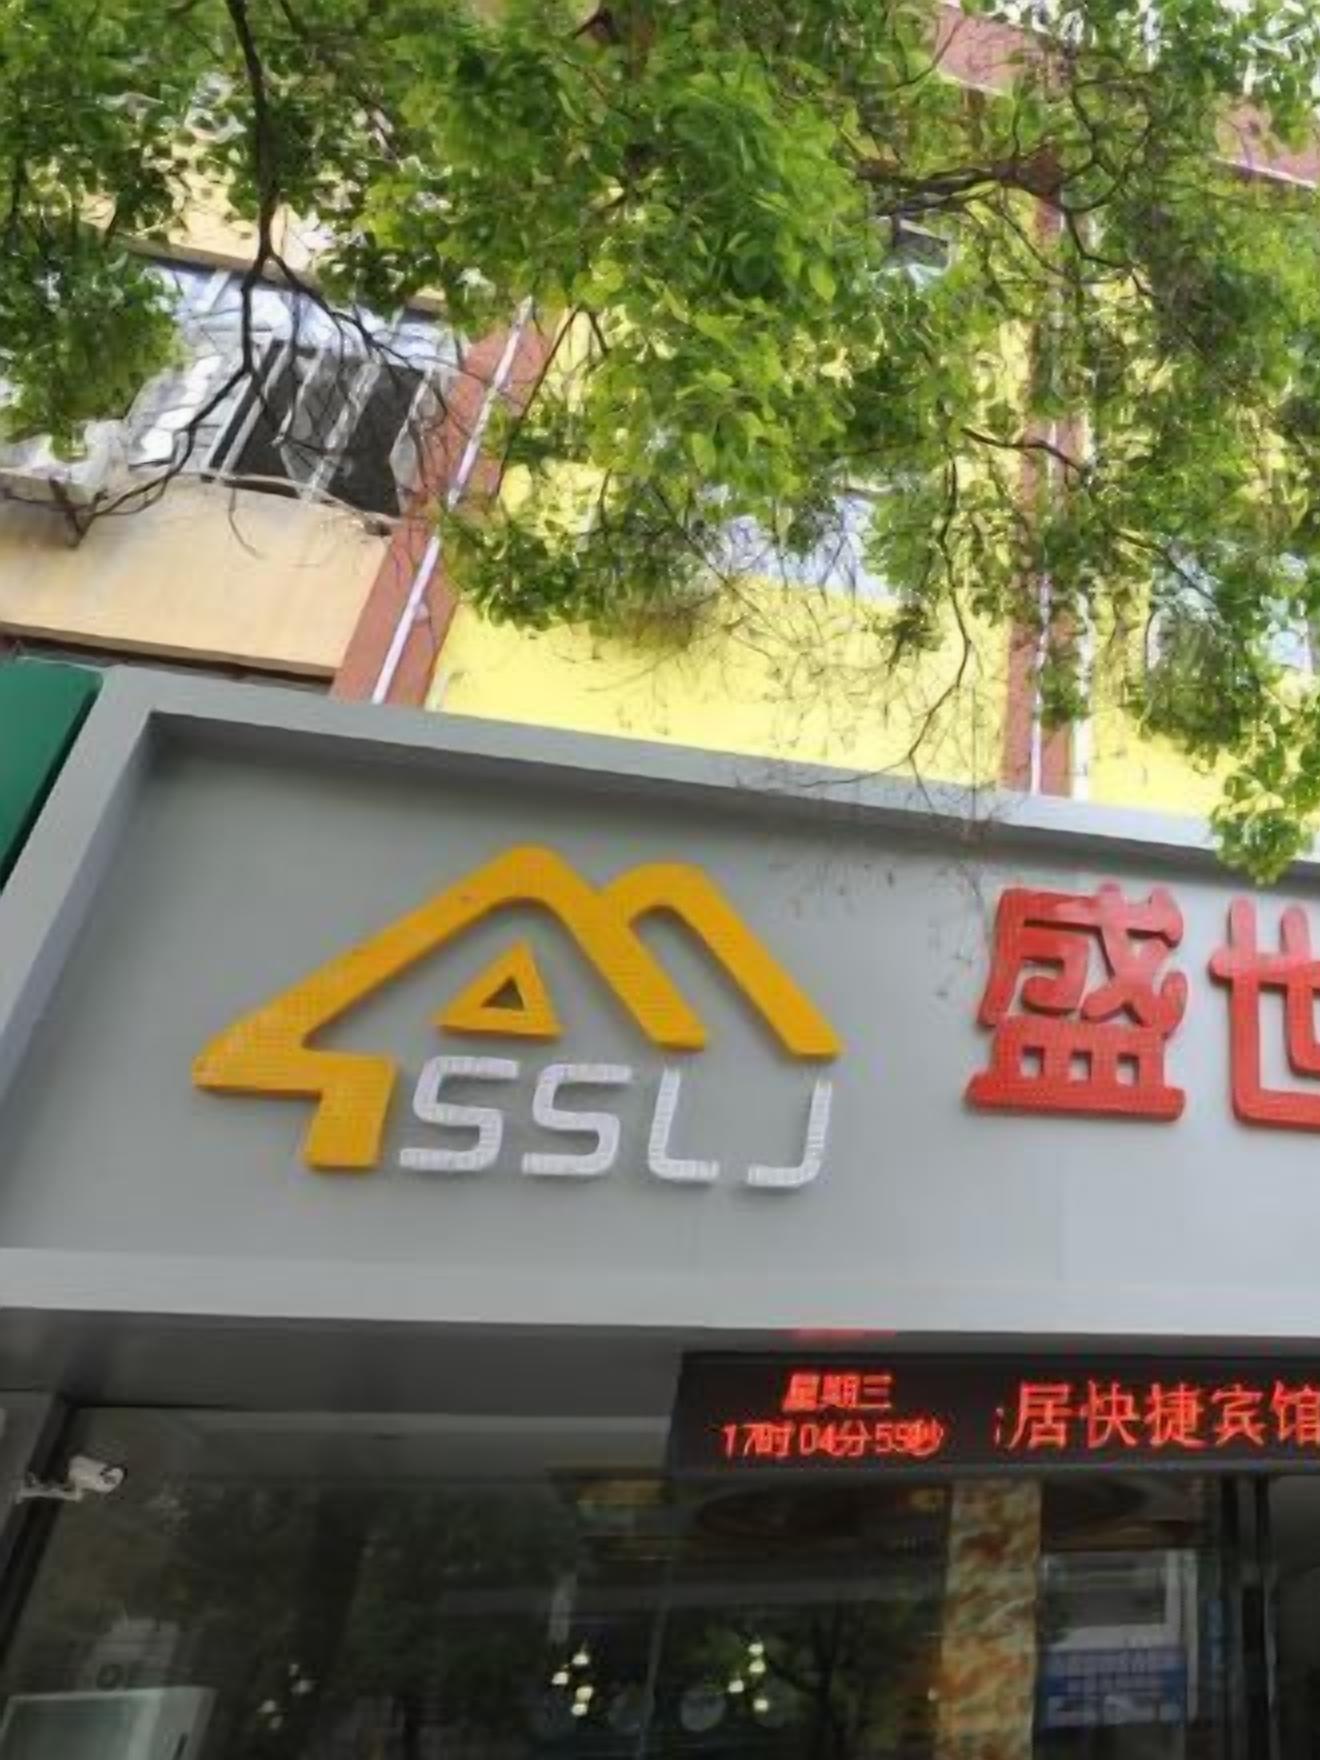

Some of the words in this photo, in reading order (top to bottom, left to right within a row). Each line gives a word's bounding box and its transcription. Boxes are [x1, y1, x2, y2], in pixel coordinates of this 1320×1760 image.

[398, 1052, 834, 1190] SSLJ
[783, 1373, 893, 1412] 星期三
